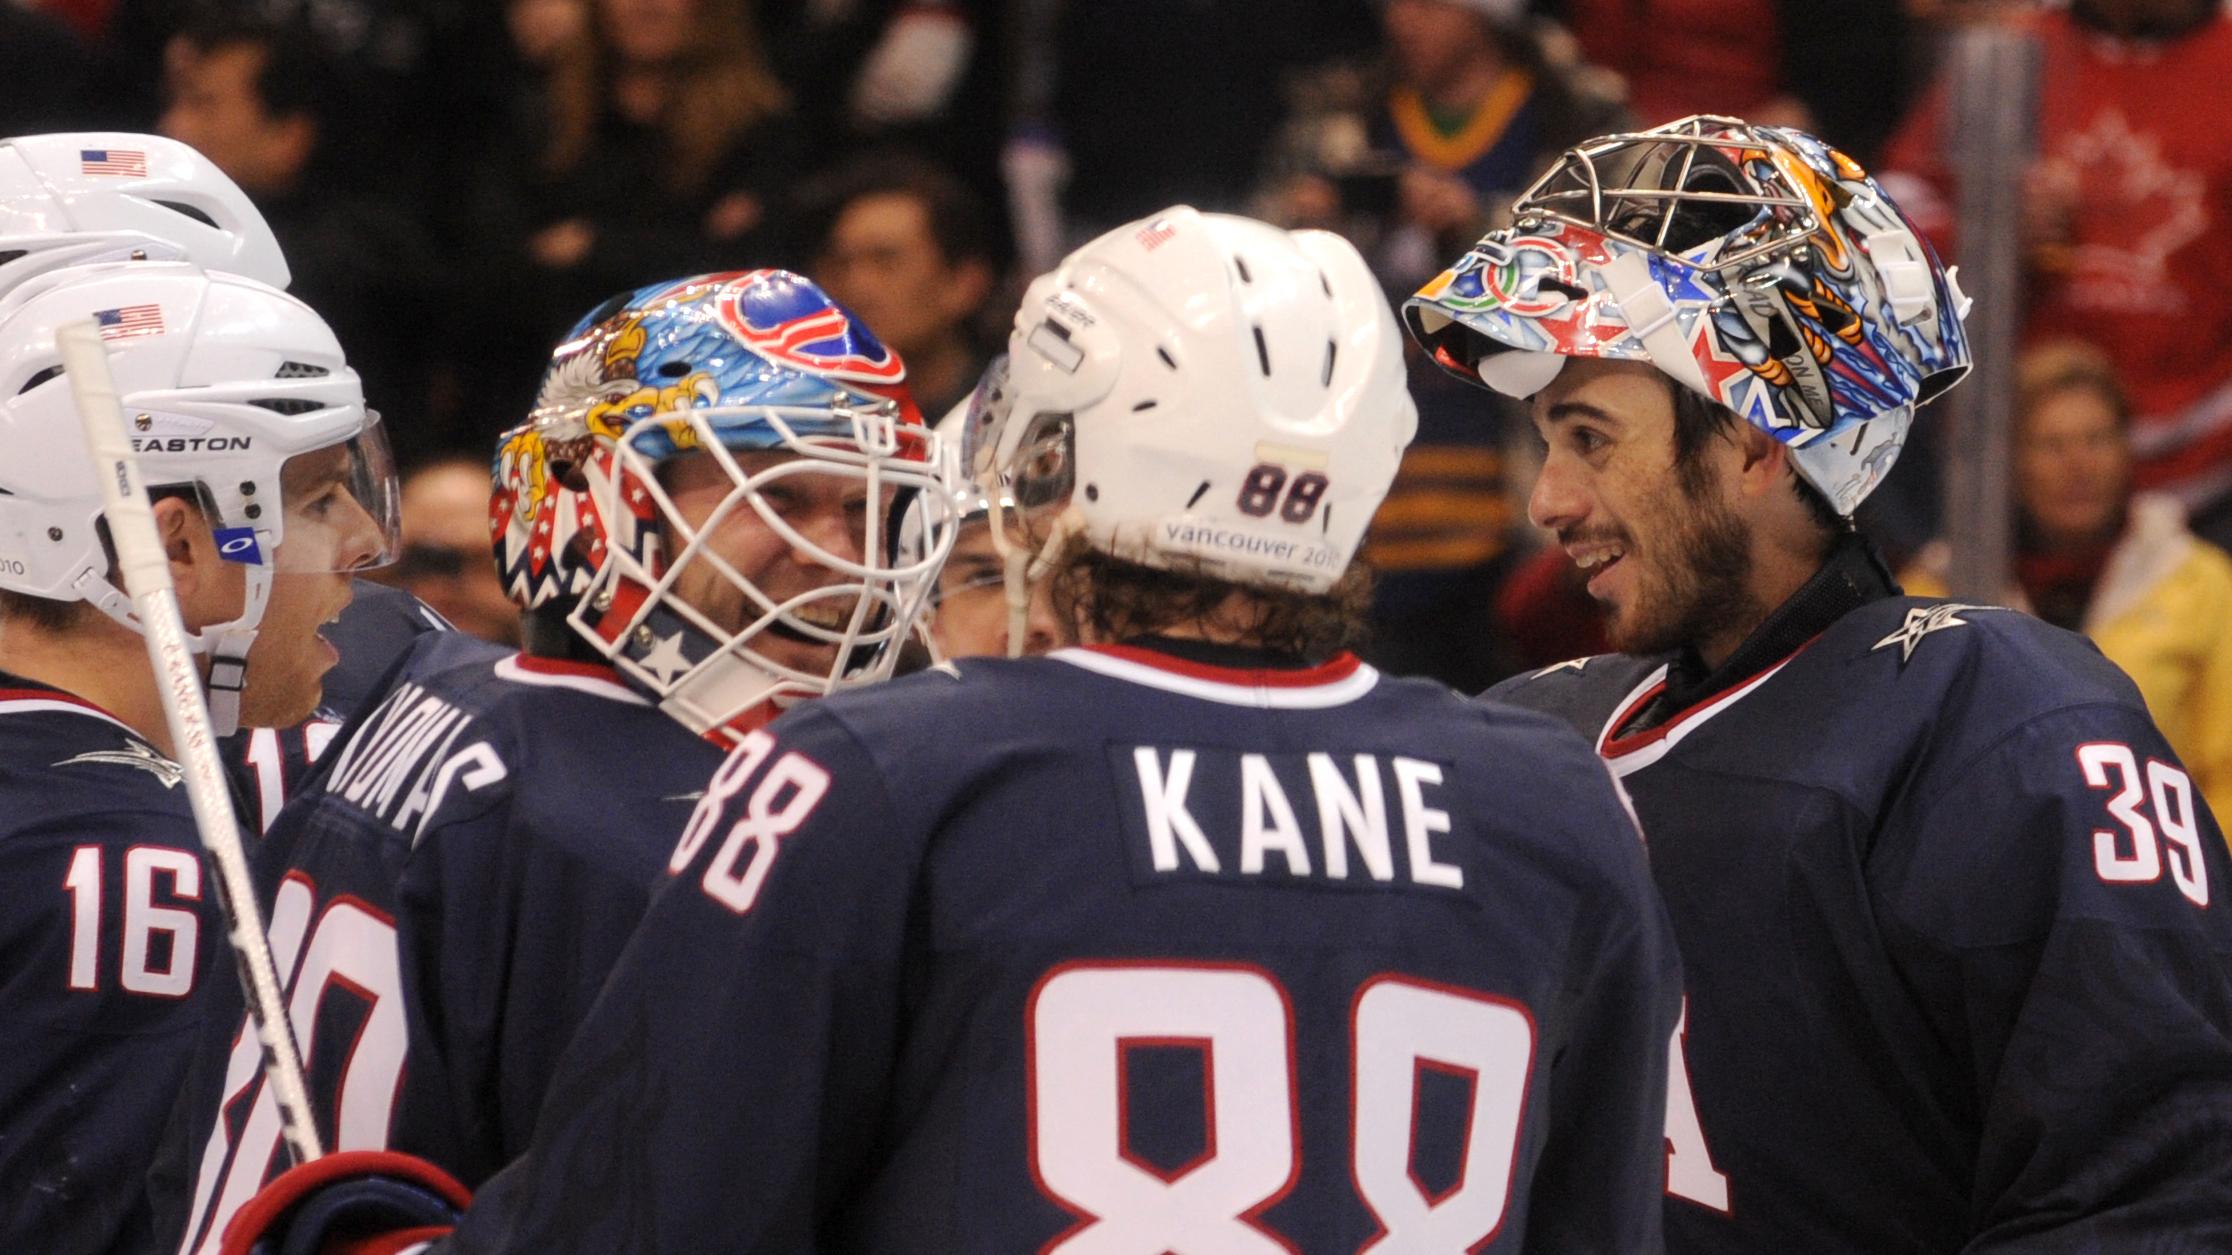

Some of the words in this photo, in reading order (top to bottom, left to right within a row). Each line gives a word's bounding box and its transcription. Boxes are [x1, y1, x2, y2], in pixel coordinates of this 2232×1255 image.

[131, 436, 252, 452] EASTON
[1236, 462, 1330, 524] 88
[1166, 523, 1299, 560] vancouver
[669, 729, 832, 914] 88
[1133, 745, 1464, 891] KANE
[2075, 741, 2209, 908] 39
[63, 843, 200, 997] 16
[1024, 957, 1539, 1255] 88
